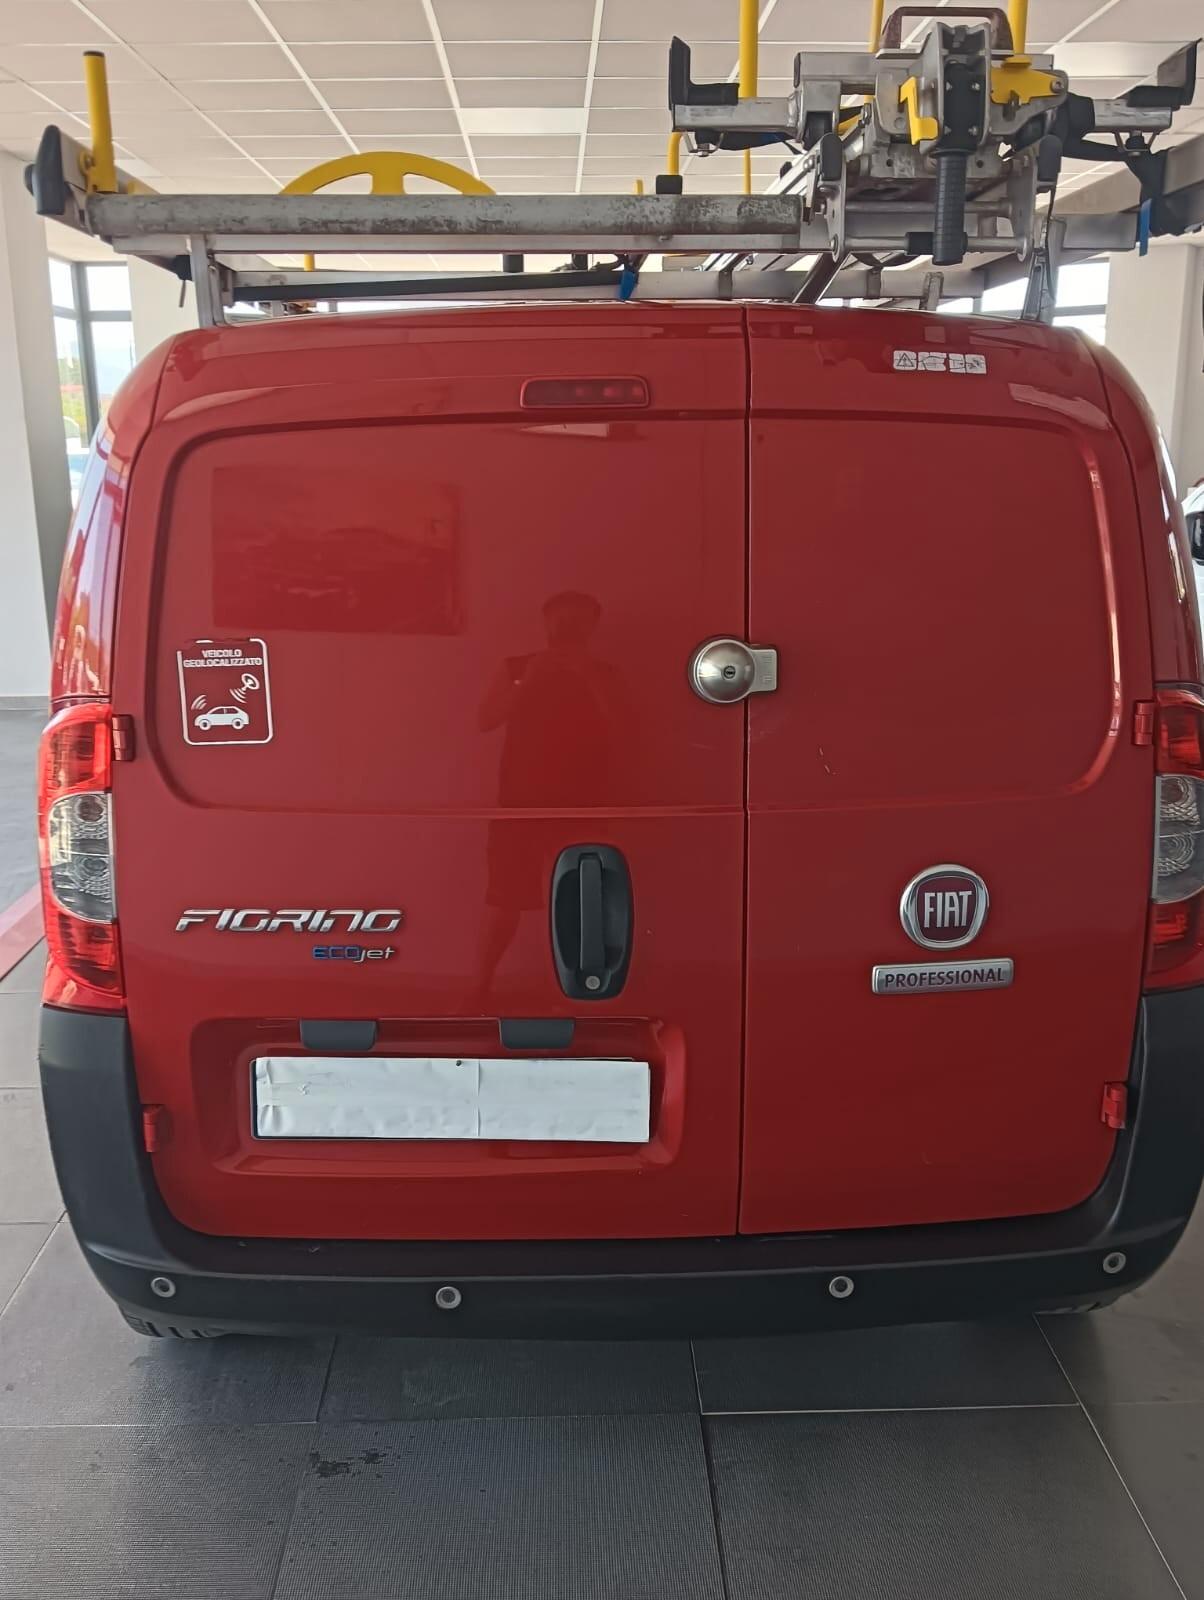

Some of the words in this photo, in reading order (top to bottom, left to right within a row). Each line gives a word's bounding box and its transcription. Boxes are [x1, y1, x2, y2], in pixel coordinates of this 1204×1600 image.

[183, 657, 263, 668] GEOLOCALIZZATO
[202, 649, 242, 658] VEICOLO
[923, 891, 973, 928] FIAT
[176, 909, 402, 932] FIORINO
[885, 967, 1005, 988] PROFESSIONAL
